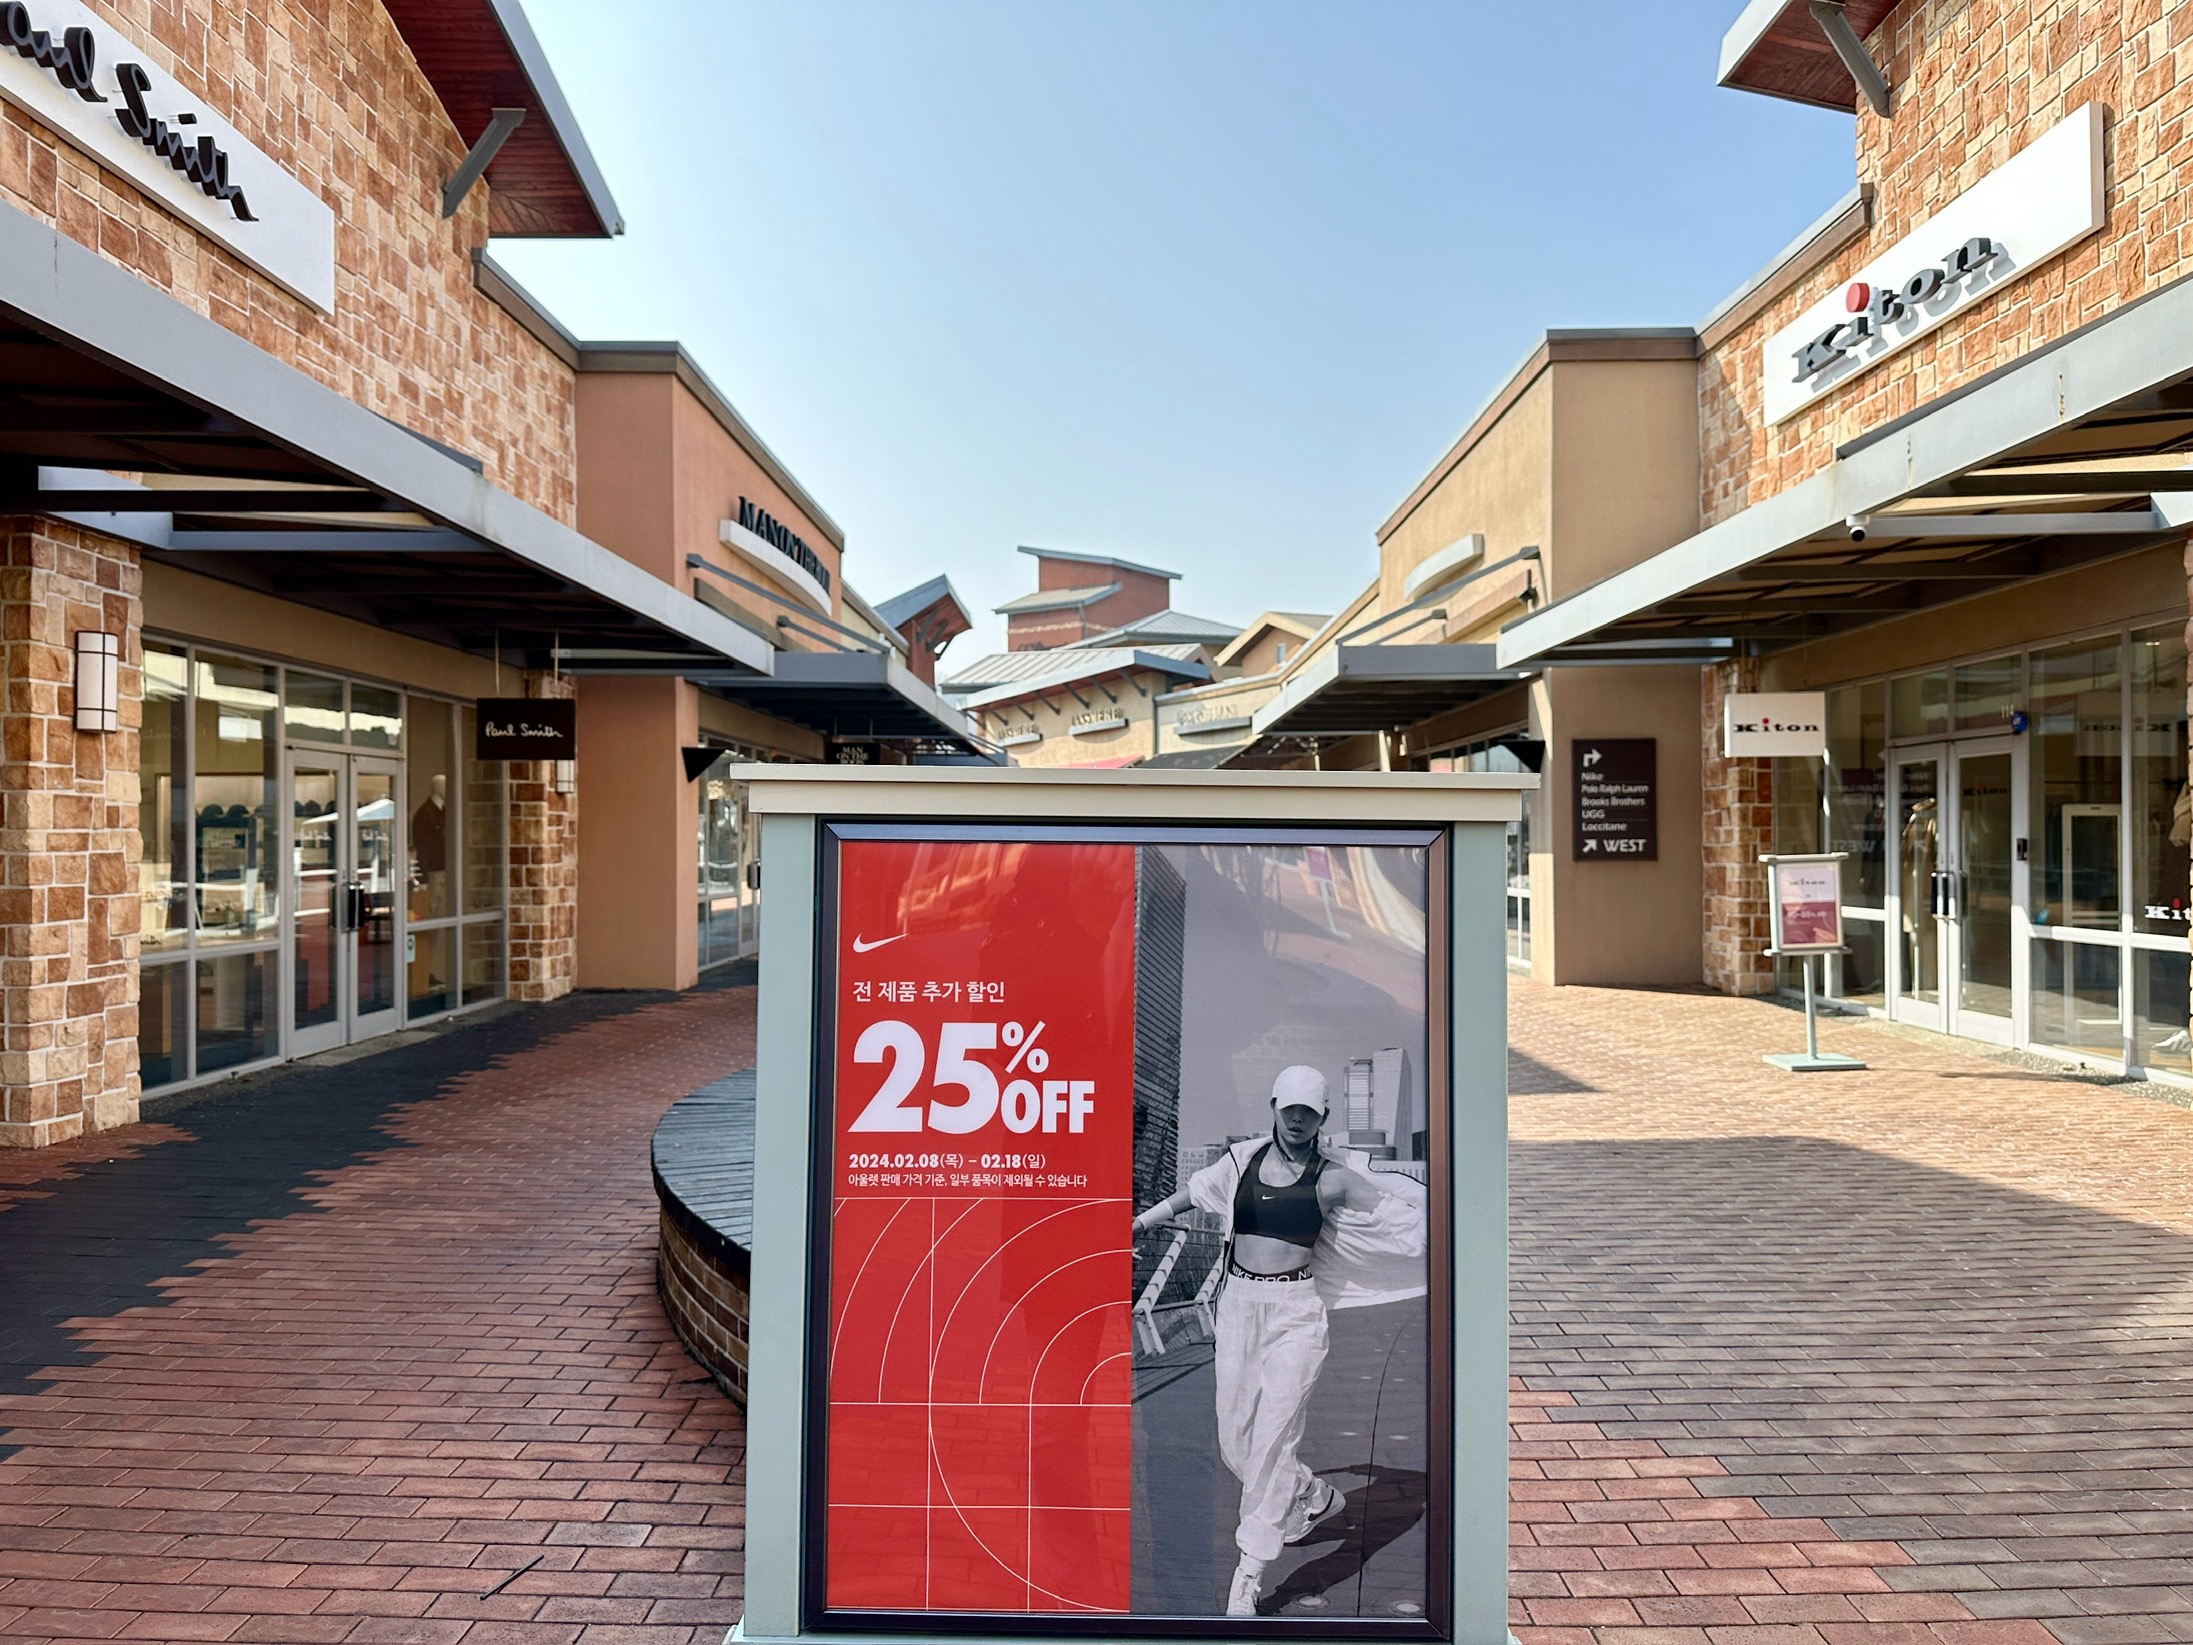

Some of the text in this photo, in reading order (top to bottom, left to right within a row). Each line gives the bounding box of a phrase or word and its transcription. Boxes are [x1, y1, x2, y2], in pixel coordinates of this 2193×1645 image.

[115, 63, 259, 221] Smith
[1791, 238, 1998, 383] Kiton
[485, 721, 564, 738] Paul Smith
[1733, 717, 1819, 733] Kiton
[1581, 772, 1604, 781] Nike
[1581, 784, 1649, 795] Polo Ralph Lauren
[1963, 784, 2008, 796] Kiton
[1581, 797, 1645, 806] Brooks Brothers
[1582, 809, 1606, 819] UGG
[1582, 822, 1628, 831] Loccitane
[1603, 839, 1647, 852] WEST
[853, 981, 1005, 1003] 전 제품 추가 할인
[848, 1020, 1095, 1134] 25% OFF
[849, 1153, 964, 1168] 2024.02.08(목)
[981, 1154, 1046, 1169] 02.18(일)
[848, 1173, 1087, 1187] 아울렛 판매 가격 기준, 일부 품목이 제외될 수 있습니다
